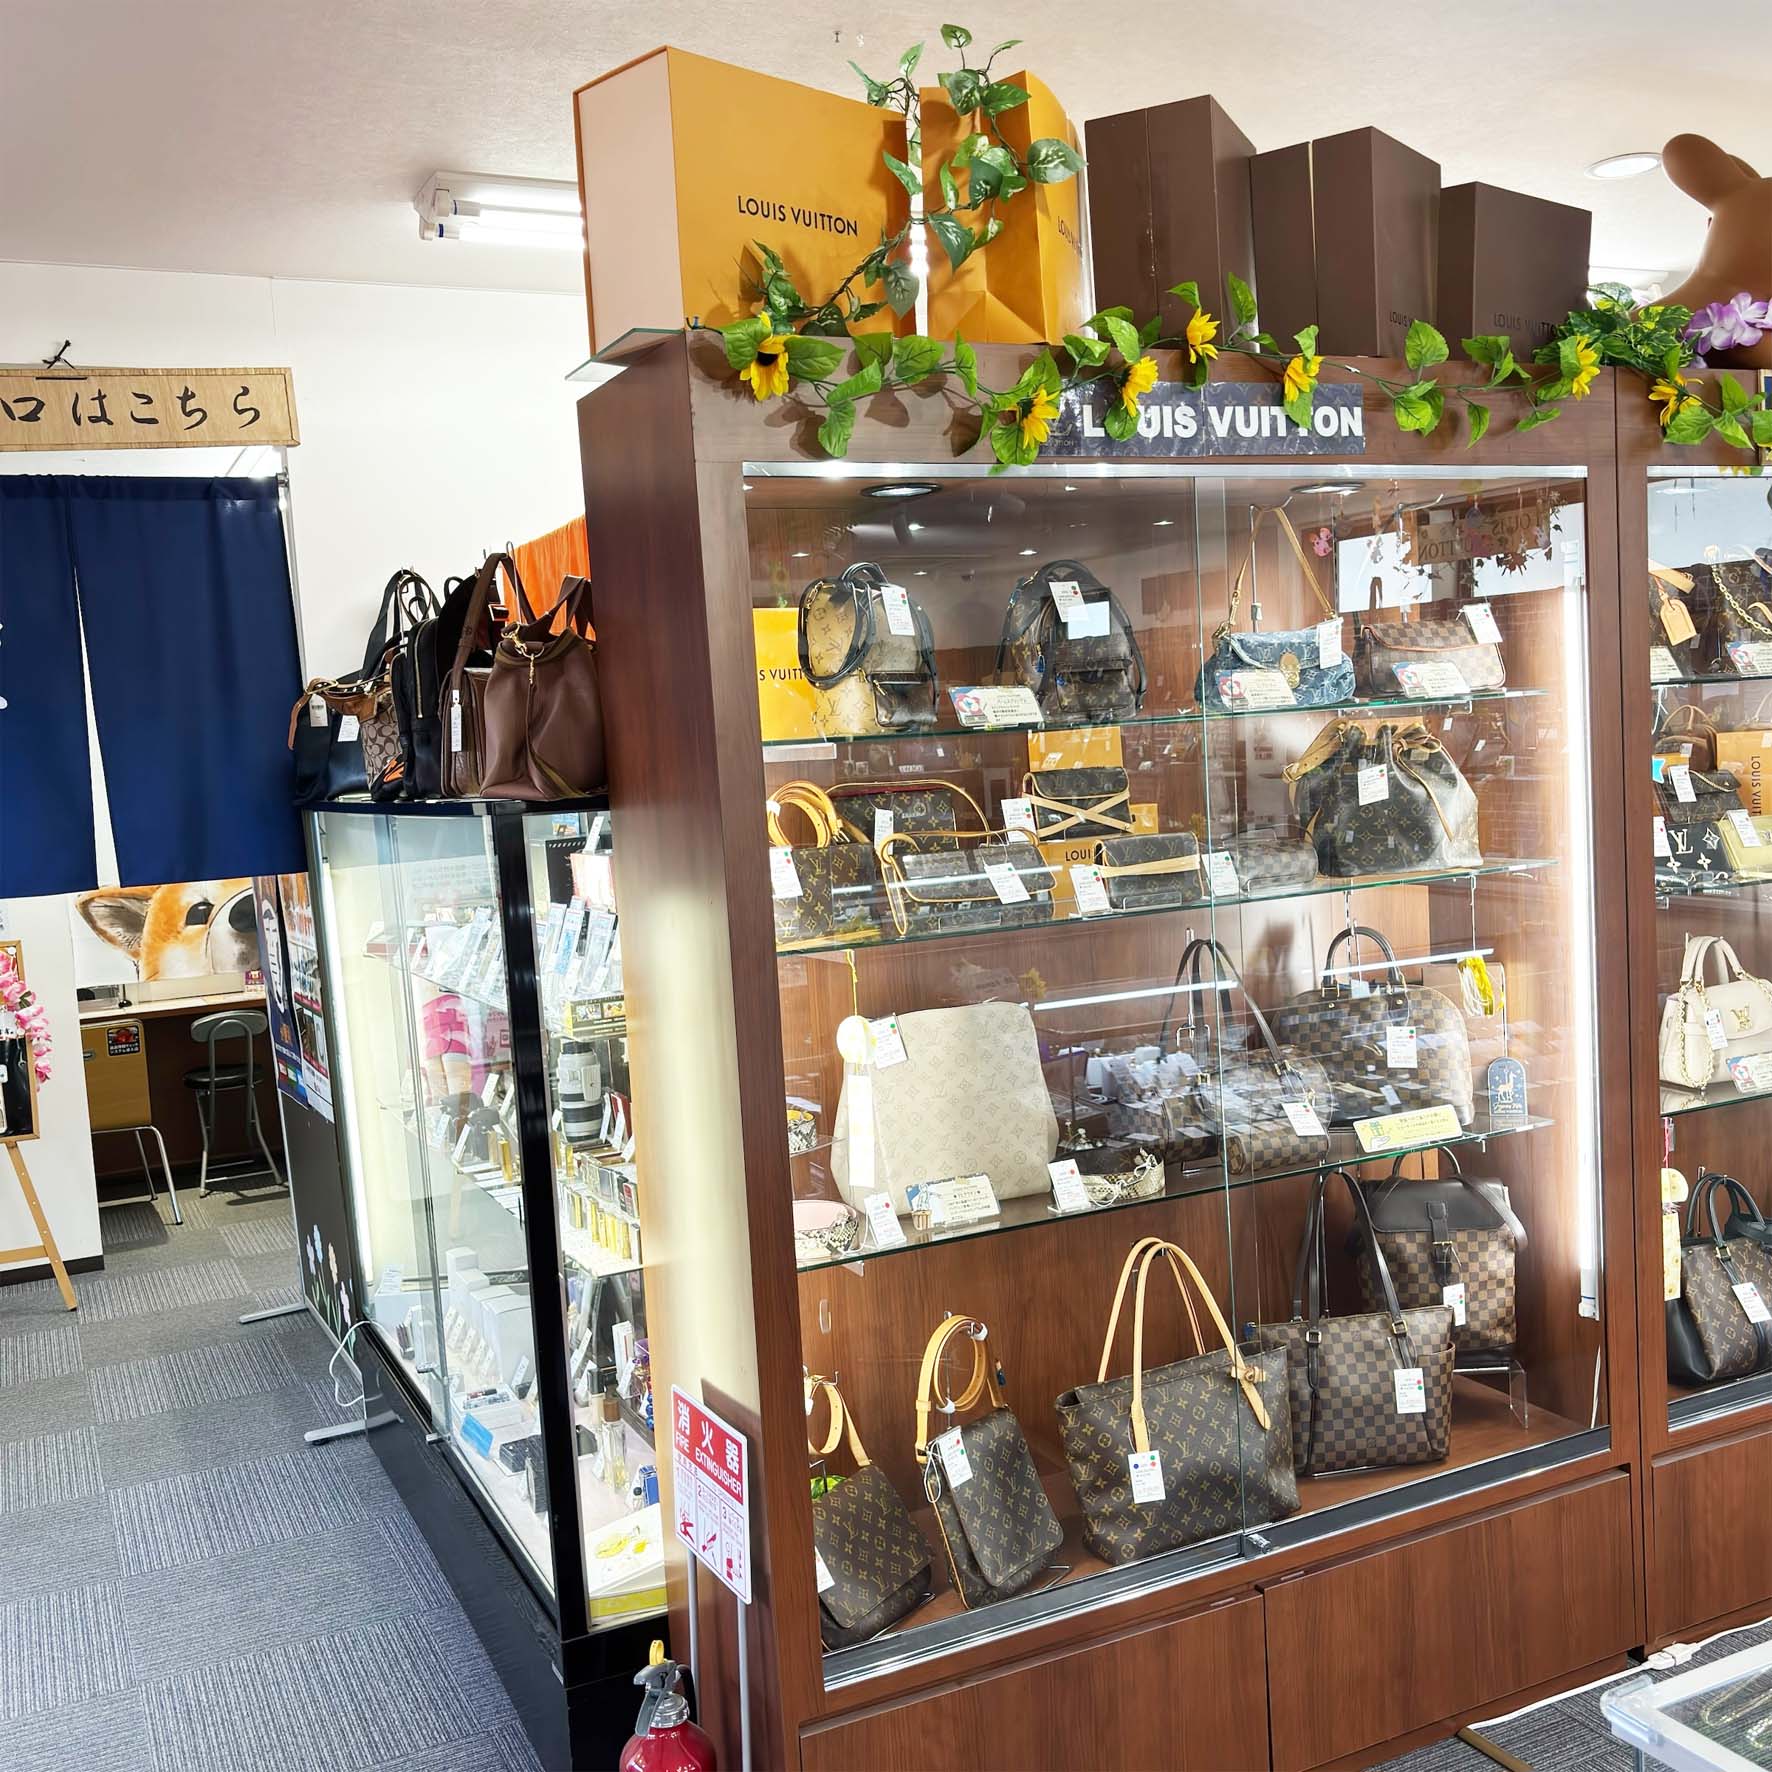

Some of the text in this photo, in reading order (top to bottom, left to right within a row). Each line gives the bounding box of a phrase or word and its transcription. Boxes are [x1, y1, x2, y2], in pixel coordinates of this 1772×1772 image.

[737, 194, 859, 238] LOUIS VUITTON
[1082, 403, 1363, 439] LUIS VUITON
[1751, 755, 1762, 788] LOUIS
[677, 1399, 740, 1476] 消火器
[675, 1430, 690, 1454] FIRE
[695, 1446, 743, 1498] EXTINGUISHER
